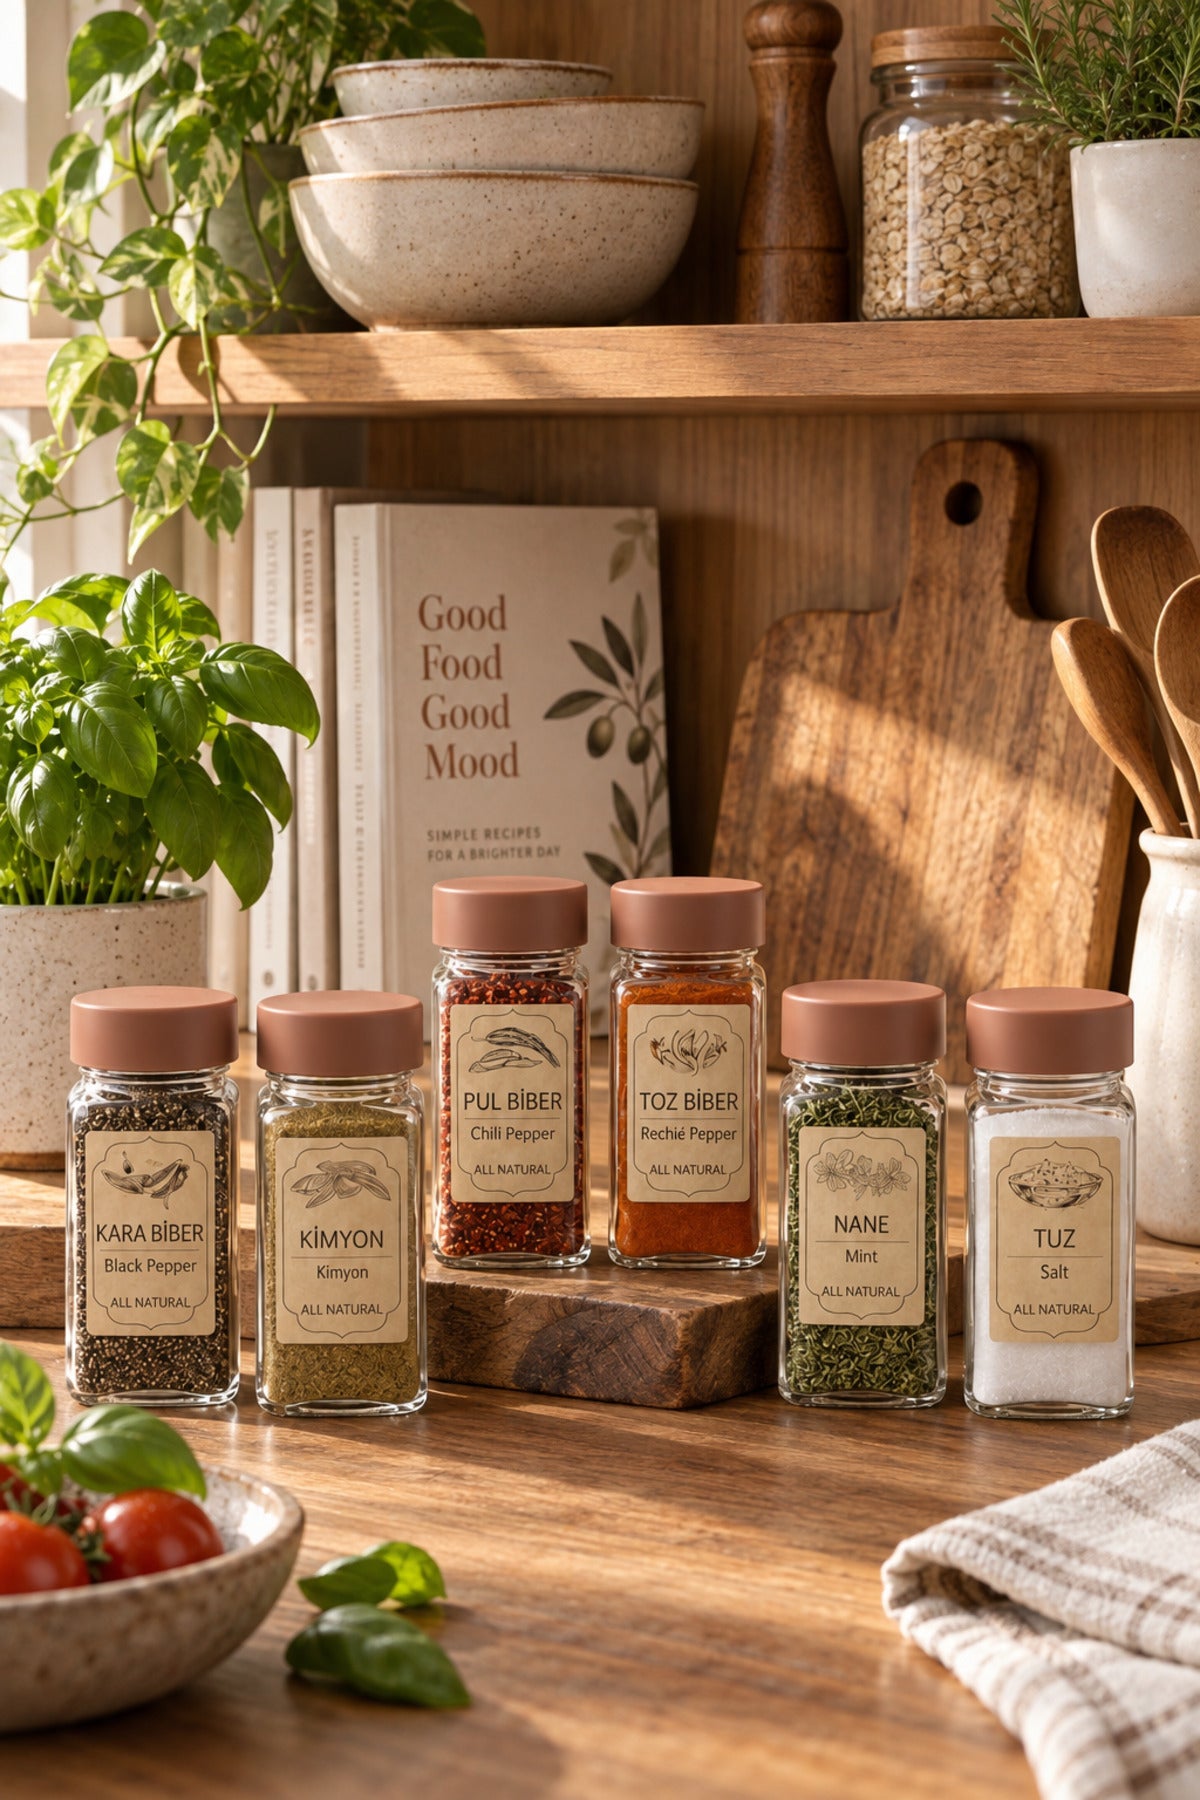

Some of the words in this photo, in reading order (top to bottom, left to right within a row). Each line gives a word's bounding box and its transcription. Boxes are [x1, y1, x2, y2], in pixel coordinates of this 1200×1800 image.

[418, 594, 507, 631] Good
[421, 644, 503, 681] Food
[421, 694, 510, 730] Good
[426, 742, 520, 780] Mood
[427, 829, 478, 842] SIMPLE
[484, 827, 541, 840] RECIPES
[428, 849, 453, 862] FOR
[457, 849, 466, 861] A
[470, 847, 533, 861] BRIGHTER
[536, 846, 561, 858] DAY
[464, 1093, 501, 1110] PUL
[508, 1088, 562, 1110] BİBER
[640, 1093, 677, 1110] TOZ
[685, 1089, 738, 1110] BİBER
[471, 1127, 501, 1140] Chili
[506, 1127, 555, 1144] Pepper
[642, 1127, 685, 1140] Rechié
[690, 1127, 736, 1143] Pepper
[474, 1165, 495, 1175] ALL
[498, 1164, 550, 1174] NATURAL
[650, 1165, 670, 1175] ALL
[674, 1164, 726, 1174] NATURAL
[96, 1224, 146, 1242] KARA
[152, 1220, 203, 1241] BİBER
[835, 1215, 889, 1233] NANE
[300, 1226, 384, 1248] KİMYON
[1034, 1229, 1075, 1248] TUZ
[846, 1250, 878, 1263] Mint
[105, 1259, 142, 1272] Black
[147, 1260, 197, 1276] Pepper
[317, 1266, 368, 1283] Kimyon
[1041, 1265, 1068, 1279] Salt
[822, 1287, 843, 1297] ALL
[846, 1286, 900, 1297] NATURAL
[110, 1297, 131, 1308] ALL
[135, 1296, 191, 1307] NATURAL
[301, 1305, 323, 1315] ALL
[326, 1303, 383, 1315] NATURAL
[1014, 1304, 1035, 1315] ALL
[1038, 1303, 1094, 1315] NATURAL
